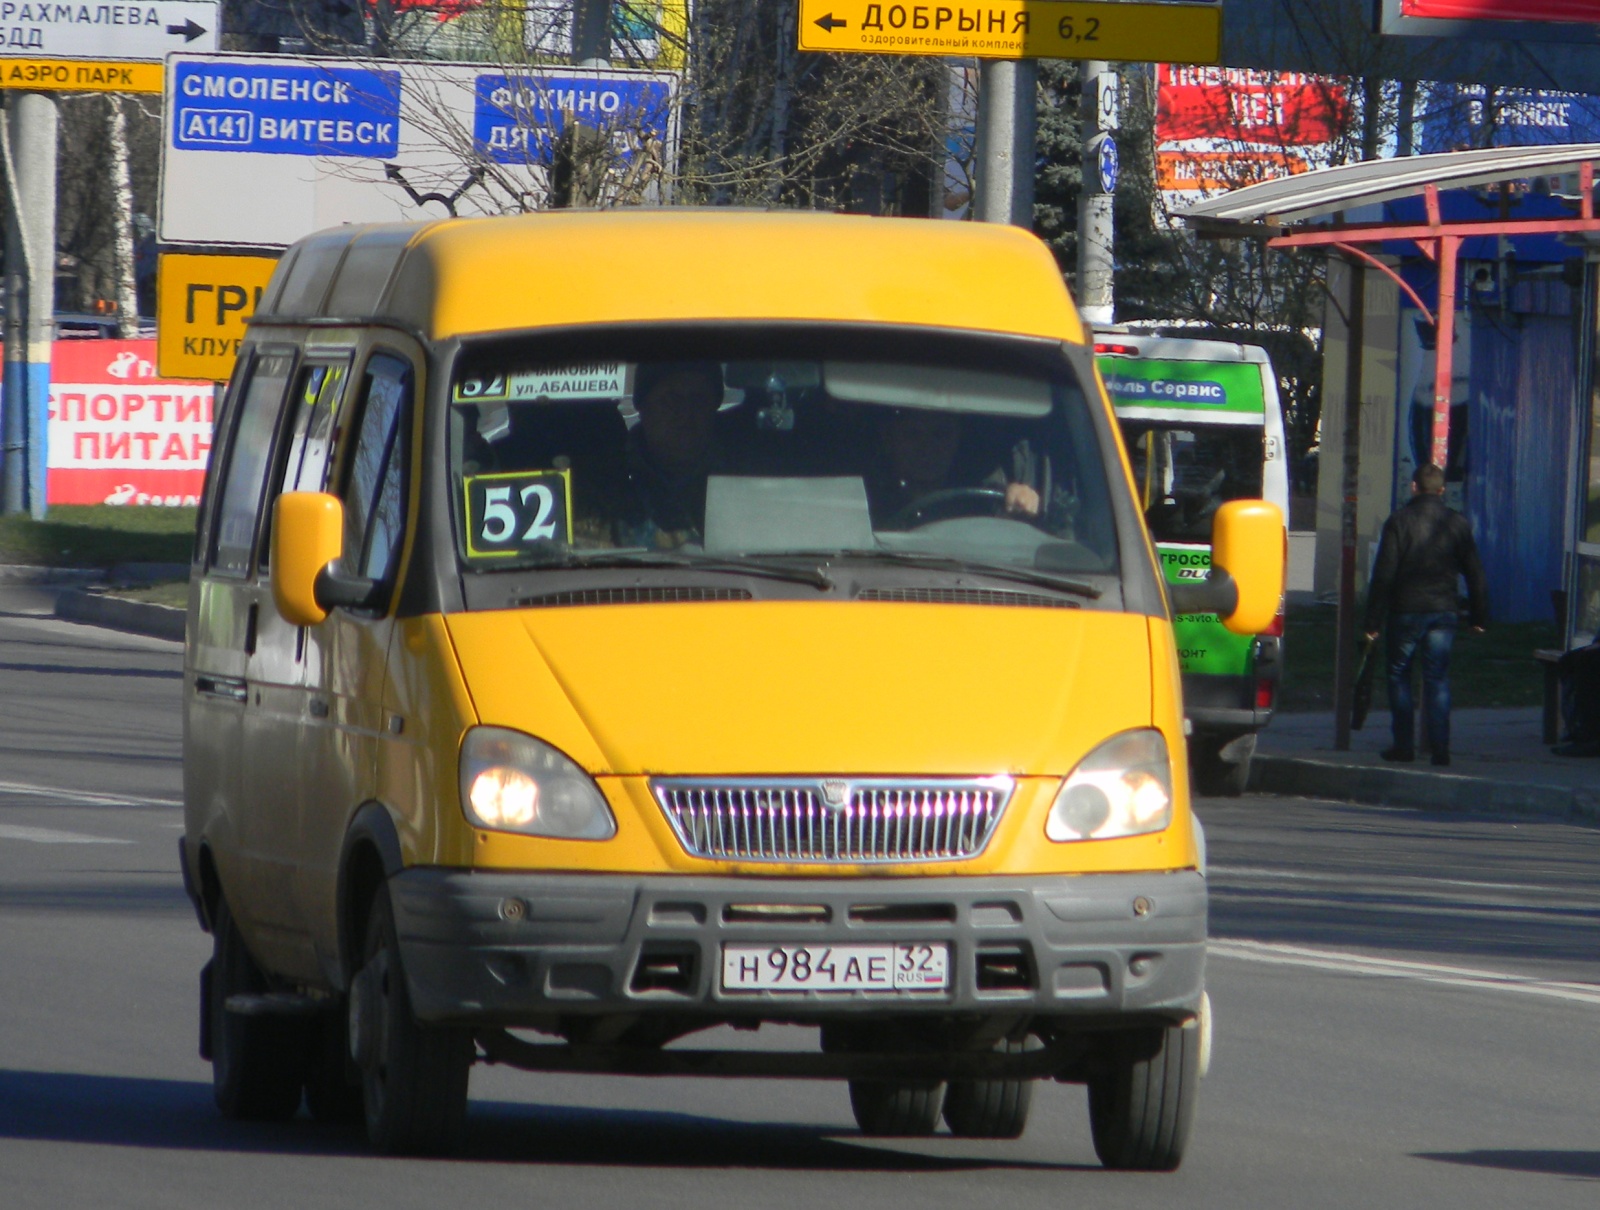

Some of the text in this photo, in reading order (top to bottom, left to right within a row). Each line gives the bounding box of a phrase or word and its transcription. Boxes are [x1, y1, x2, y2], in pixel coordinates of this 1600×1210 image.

[861, 3, 1100, 41] ДОБРЫНЯ 6,2
[860, 34, 1029, 50] оздоровительный комплекс
[10, 65, 69, 82] АЭРО
[76, 67, 133, 84] ПАРК
[182, 73, 351, 104] СМОЛЕНСК
[490, 87, 620, 113] ФОКИНО
[259, 117, 393, 144] ВИТЕБСК
[515, 378, 620, 395] ул.АБАШЕВА
[1150, 380, 1222, 398] Сервис
[481, 484, 556, 542] 52
[739, 945, 933, 983] Н984АЕ 32
[897, 972, 923, 983] RUS
